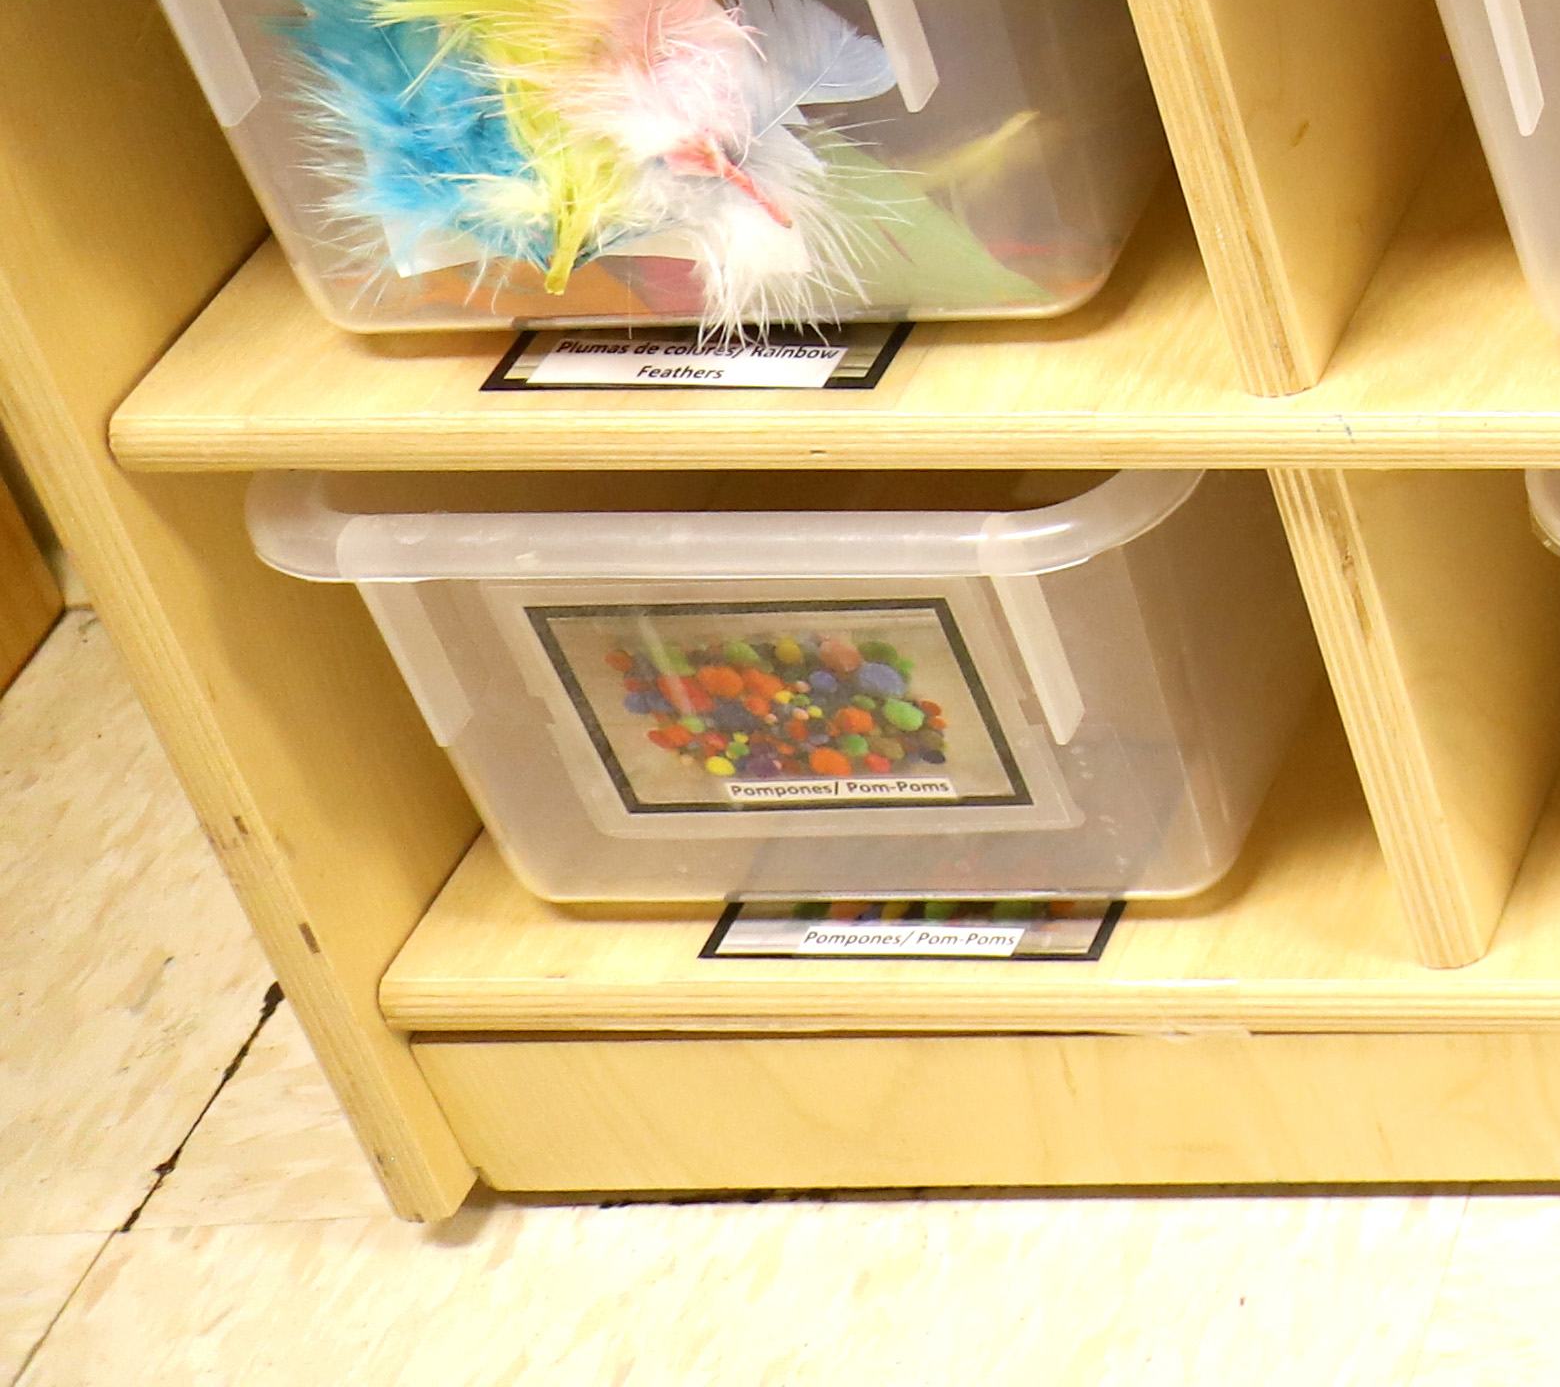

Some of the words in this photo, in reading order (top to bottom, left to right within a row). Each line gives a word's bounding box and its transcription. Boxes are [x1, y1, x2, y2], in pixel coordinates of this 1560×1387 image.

[557, 340, 627, 354] Plumas
[634, 341, 660, 355] de
[752, 344, 840, 359] Rainbow
[637, 365, 724, 379] Feathers
[731, 781, 839, 797] Pompones/
[847, 780, 950, 794] Pom-Poms
[804, 930, 915, 947] Pompones/
[916, 931, 1016, 946] Pom-Poms
